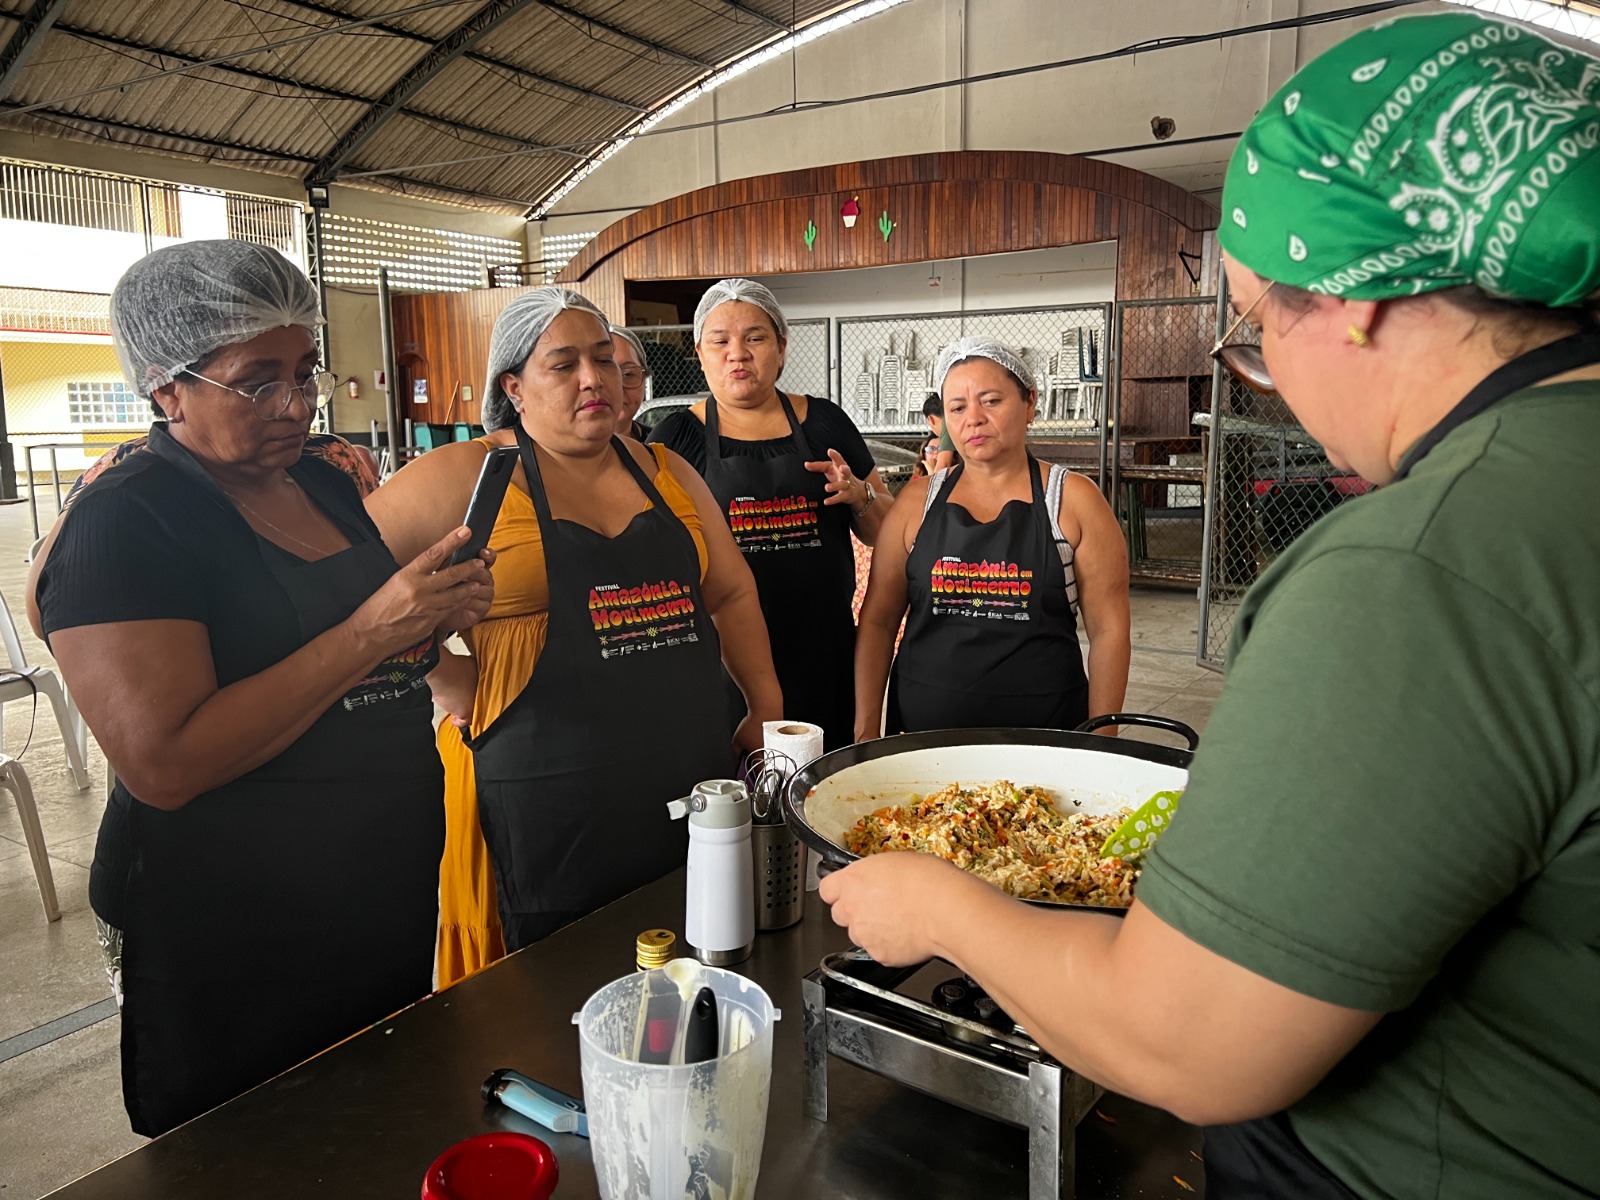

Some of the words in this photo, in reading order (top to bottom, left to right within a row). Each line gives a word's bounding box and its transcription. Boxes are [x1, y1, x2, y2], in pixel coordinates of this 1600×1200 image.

[729, 495, 807, 515] Amazônia
[730, 511, 817, 531] Movimento
[931, 559, 1018, 578] Amazônia
[588, 580, 682, 609] Amazônia
[595, 584, 620, 592] FESTIVAL
[931, 575, 1032, 596] Movimento
